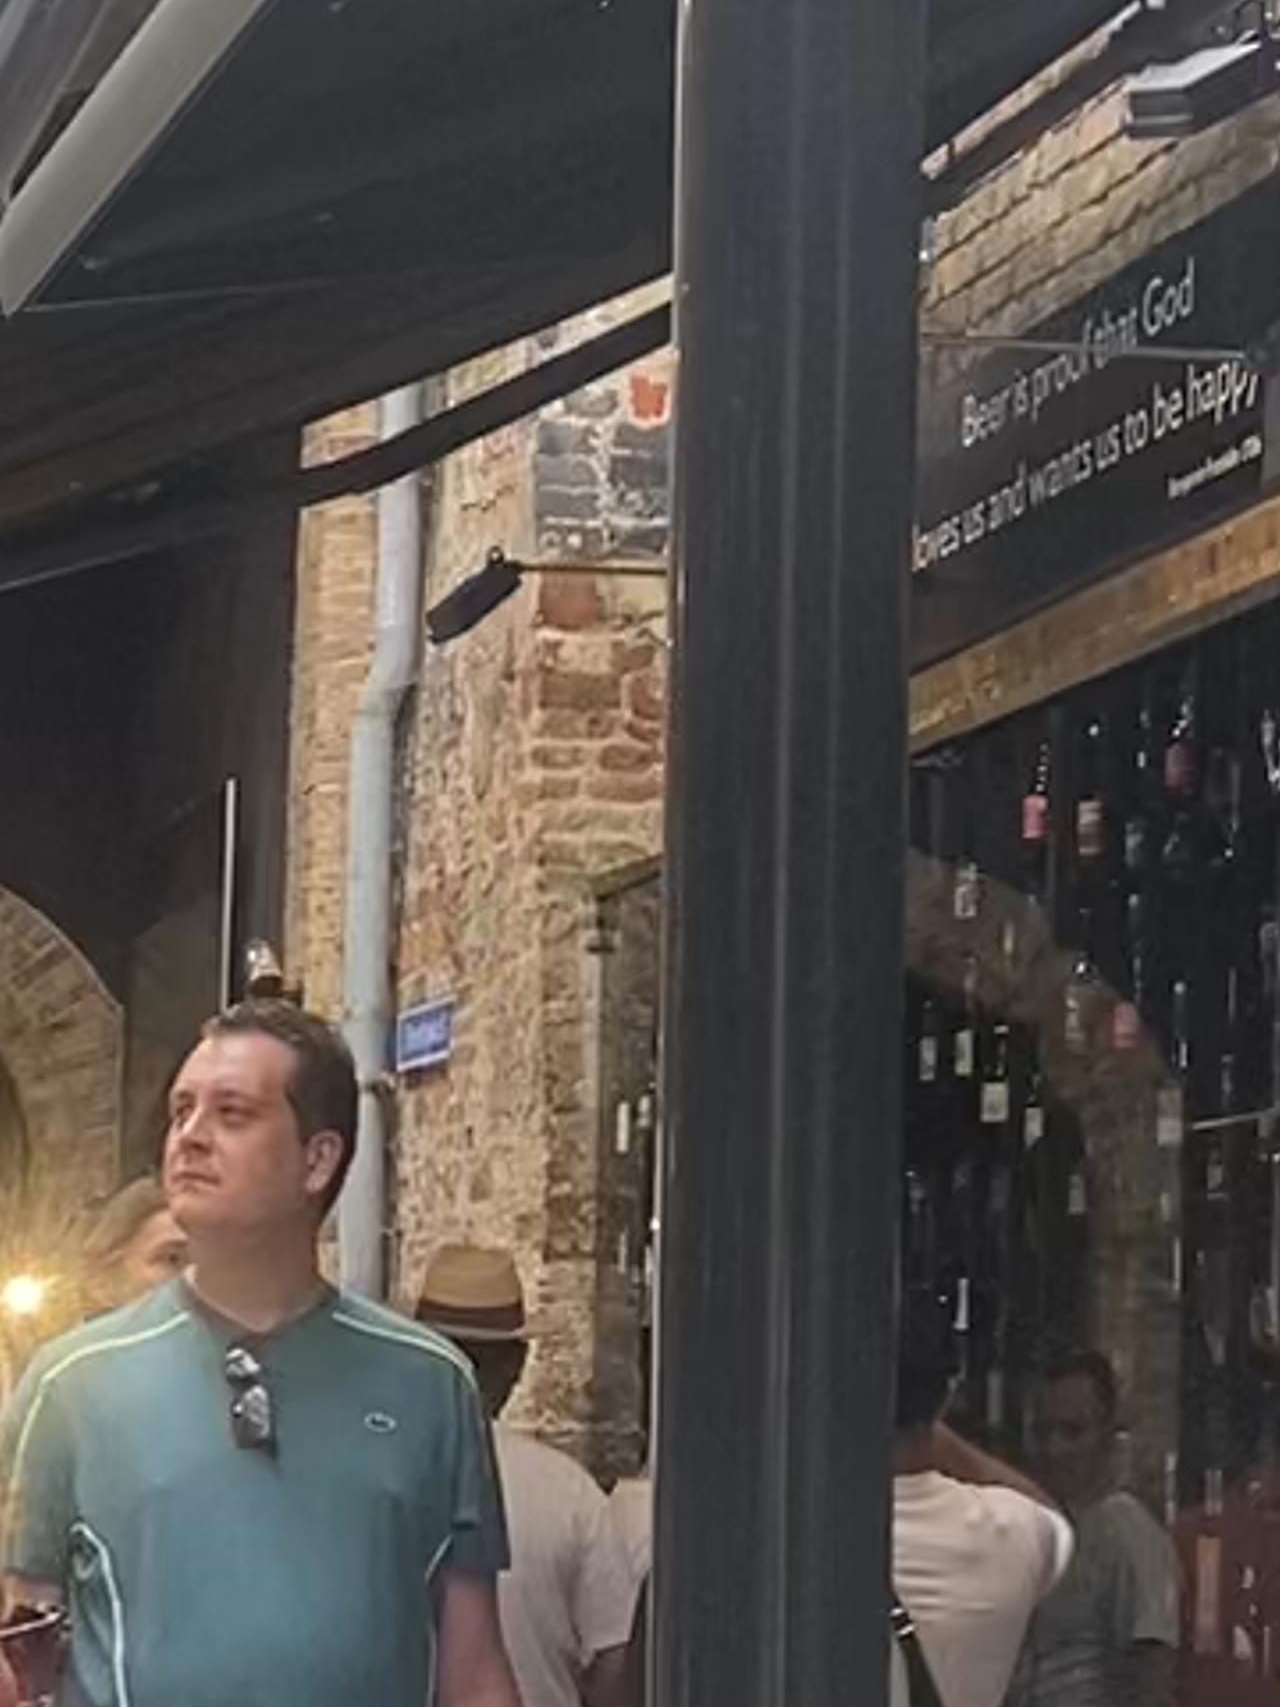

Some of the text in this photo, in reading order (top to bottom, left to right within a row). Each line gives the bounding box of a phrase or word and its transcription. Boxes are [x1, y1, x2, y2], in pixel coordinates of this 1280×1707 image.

[962, 387, 1010, 448] Beer
[1014, 369, 1029, 415] is
[1142, 255, 1195, 337] God
[911, 515, 961, 573] loves
[962, 500, 985, 544] us
[989, 459, 1027, 531] and
[1028, 439, 1092, 511] wants
[1093, 423, 1120, 470] us
[1124, 409, 1149, 455] to
[1152, 381, 1184, 440] be
